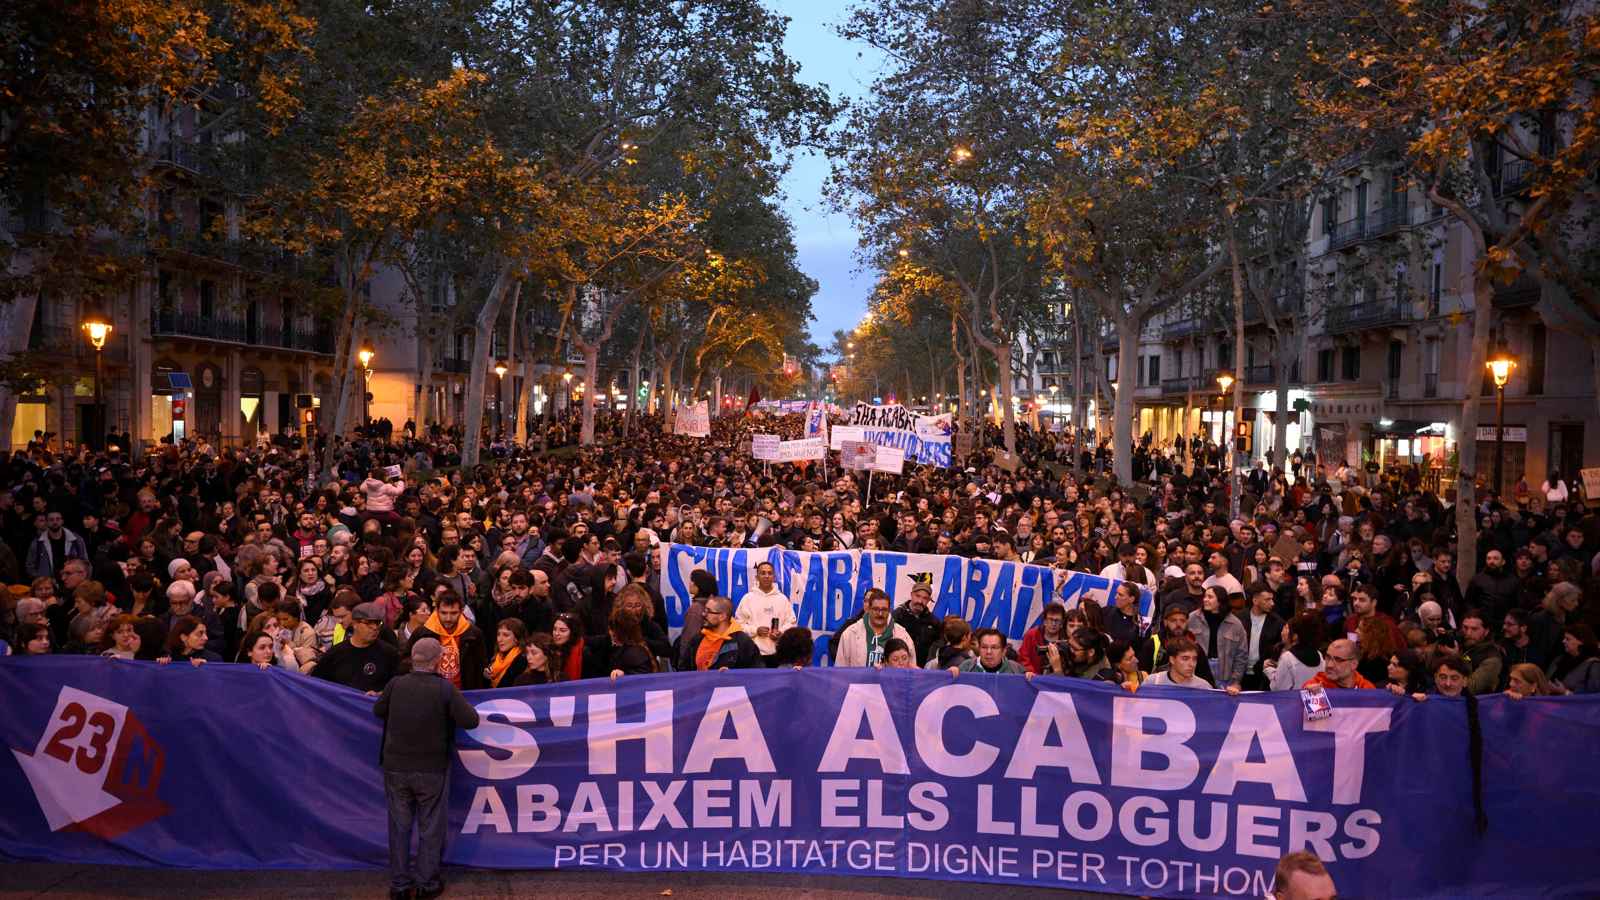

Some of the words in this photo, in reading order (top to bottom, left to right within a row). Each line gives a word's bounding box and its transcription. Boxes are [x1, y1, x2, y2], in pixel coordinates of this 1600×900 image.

[43, 702, 116, 775] 23
[457, 686, 777, 780] S'HA
[817, 683, 1395, 806] ACABAT
[460, 779, 792, 834] ABAIXEM
[820, 779, 950, 832] ELS
[976, 783, 1383, 863] LLOGUERS
[553, 842, 626, 869] PER
[640, 841, 689, 869] UN
[702, 839, 896, 872] HABITATGE
[907, 842, 1020, 878] DIGNE
[1032, 849, 1106, 883] PER
